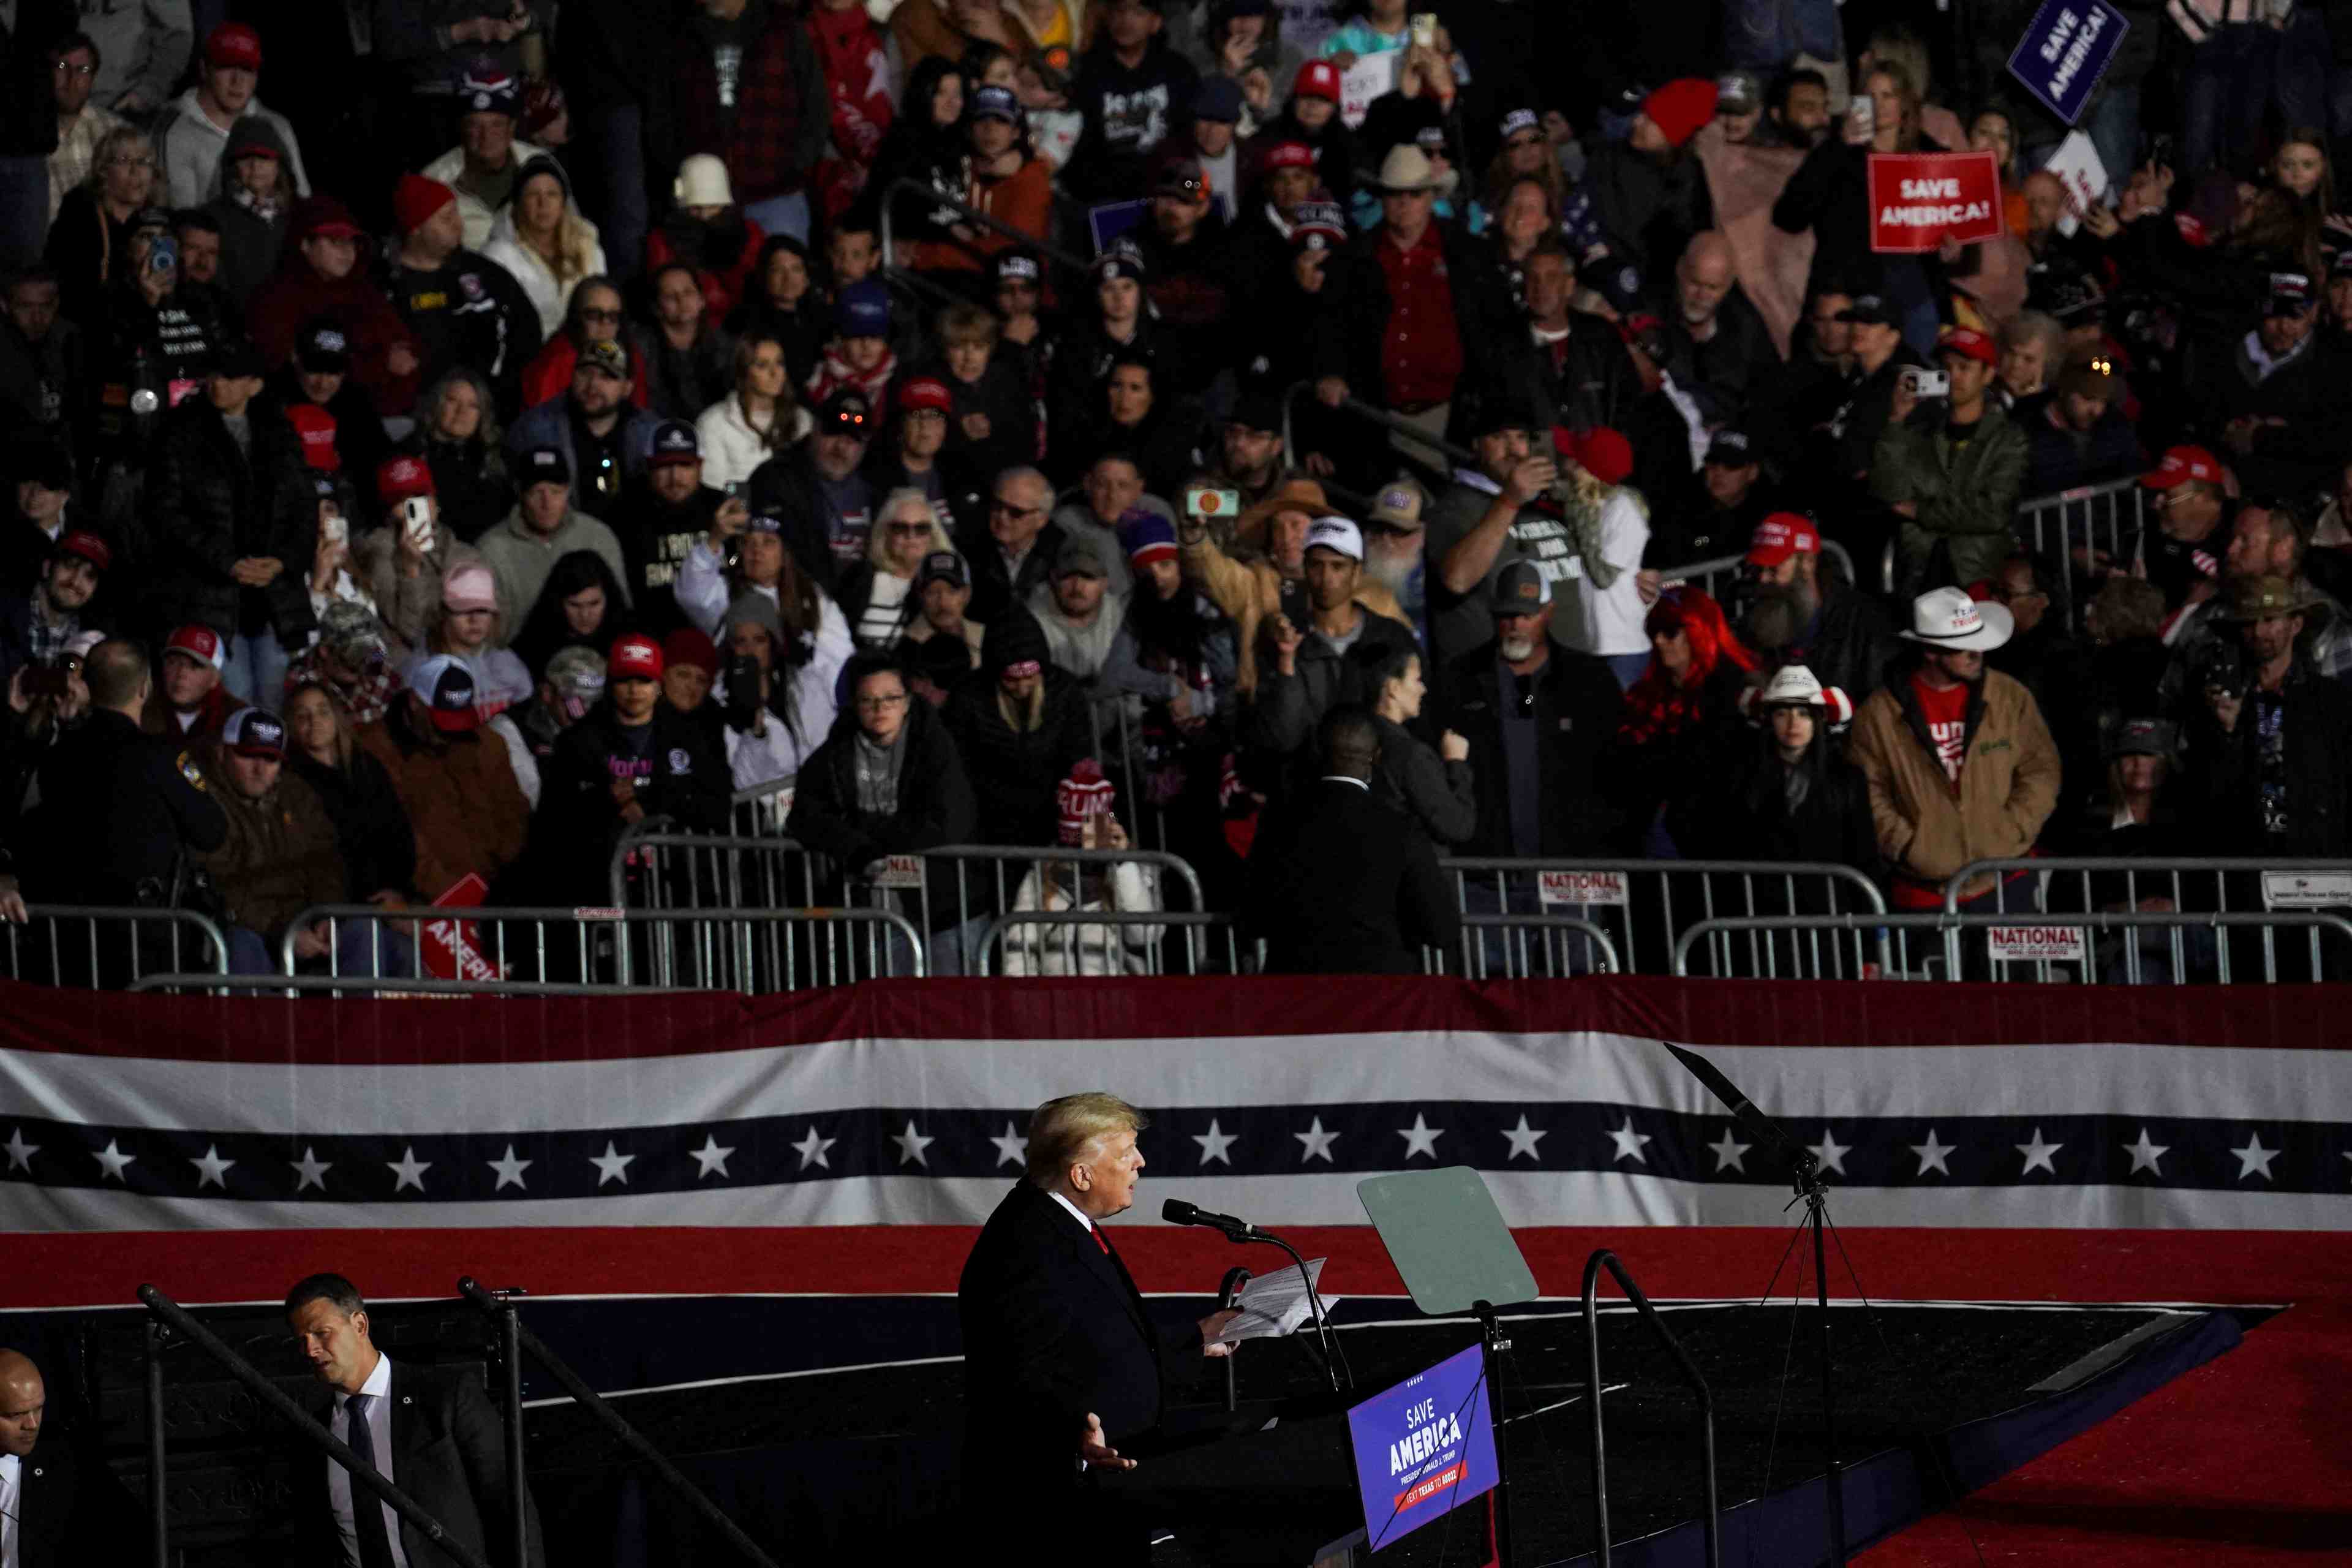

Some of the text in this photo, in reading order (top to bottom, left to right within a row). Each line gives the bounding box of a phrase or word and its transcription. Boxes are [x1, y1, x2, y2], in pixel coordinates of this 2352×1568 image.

[2040, 7, 2079, 64] SAVE
[2048, 4, 2109, 102] AMERICA!
[1899, 178, 1961, 200] SAVE
[1879, 199, 1990, 227] AMERICA!
[1544, 872, 1622, 892] NATIONAL
[1993, 929, 2080, 944] NATIONAL
[1406, 1397, 1435, 1429] SAVE
[1390, 1412, 1462, 1477] AMERICA
[1442, 1450, 1456, 1463] TRUMP
[1406, 1489, 1418, 1504] TEXT
[1418, 1481, 1434, 1497] TEXAS
[1434, 1477, 1442, 1488] TO
